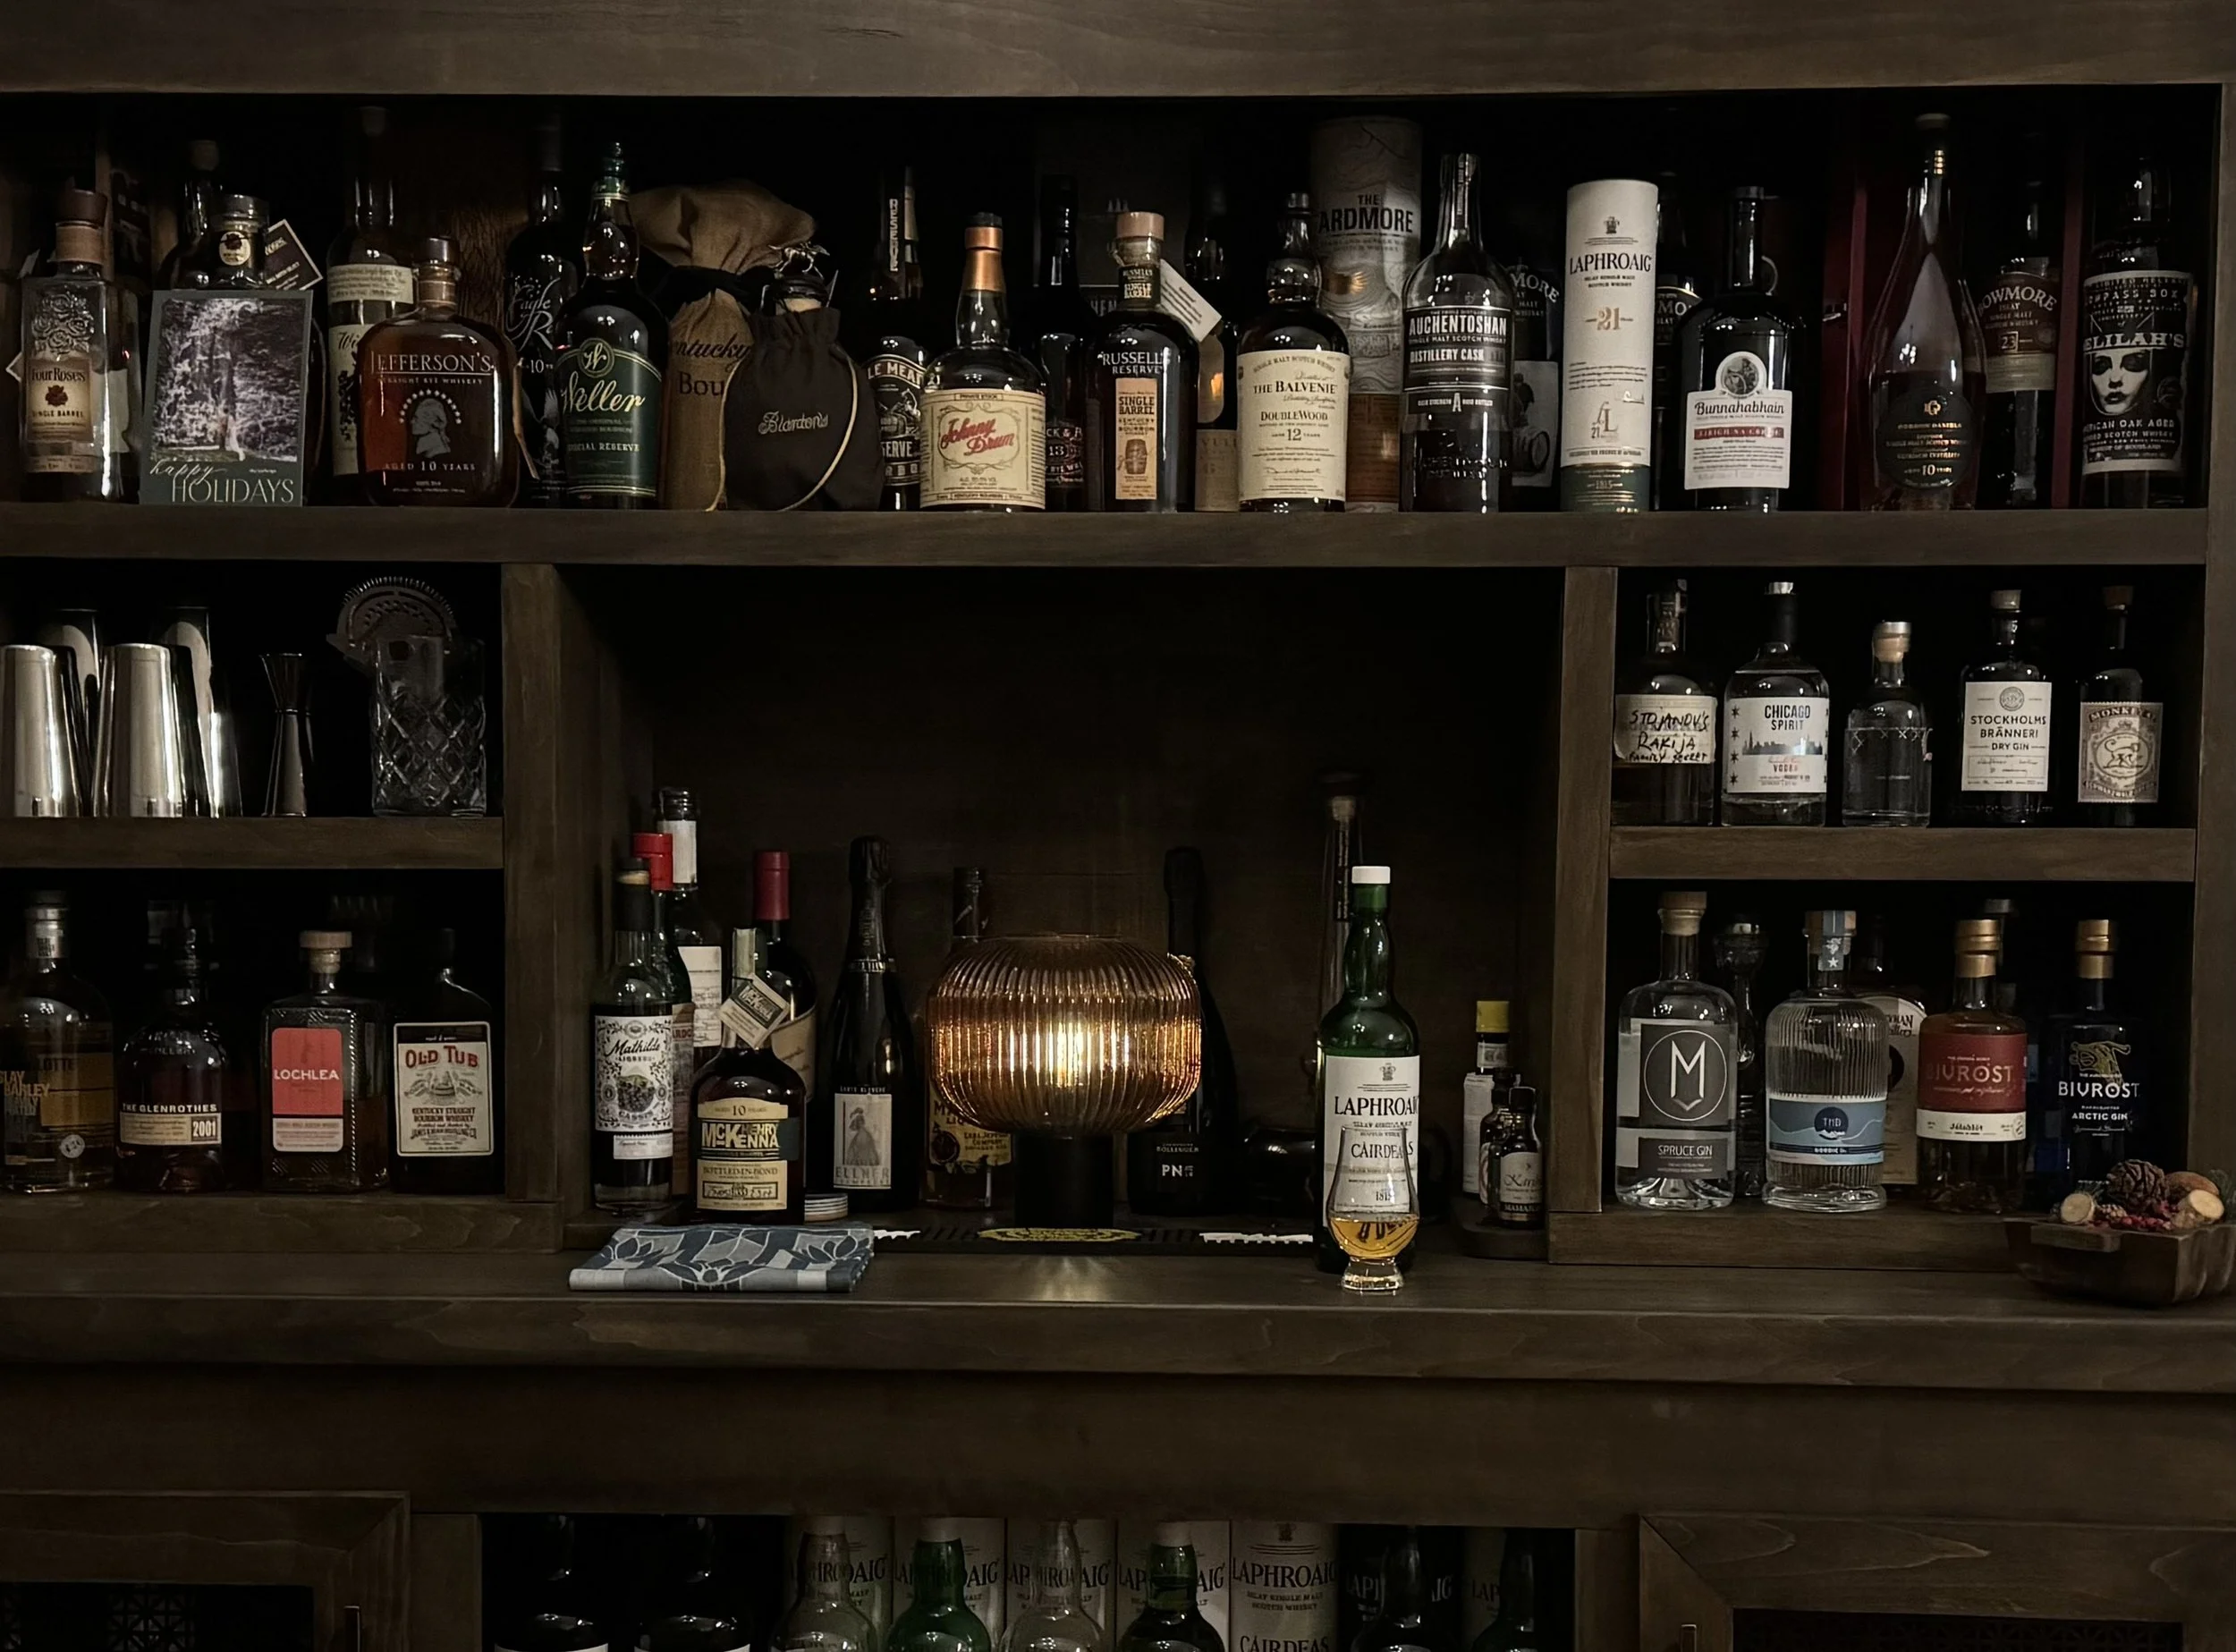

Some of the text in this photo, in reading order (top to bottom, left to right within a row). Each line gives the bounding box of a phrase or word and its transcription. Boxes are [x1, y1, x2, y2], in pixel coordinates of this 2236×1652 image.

[1359, 194, 1378, 206] THE
[1318, 207, 1413, 233] ARDMORE
[1570, 253, 1653, 275] LAPHROAIG
[1409, 314, 1508, 336] AUCHENTOSHAN
[371, 351, 492, 372] JEFFERSON'S
[1410, 348, 1485, 363] DISTILLERY CASK
[530, 360, 545, 374] 10
[1112, 365, 1163, 376] RESERVE
[54, 367, 86, 382] Roses
[560, 369, 646, 414] Weller
[1254, 380, 1338, 394] THE BALVENIE
[1118, 395, 1155, 407] SINGLE
[1694, 400, 1784, 416] Bunnahabhain
[1118, 406, 1155, 415] BARREL
[758, 411, 830, 435] Blanton's
[2119, 418, 2176, 428] OAK AGED
[941, 418, 996, 450] Johnny
[1286, 428, 1302, 442] 12
[963, 433, 1015, 457] Drum
[1049, 445, 1065, 456] 13
[420, 460, 437, 471] 10
[1921, 463, 1936, 476] 10
[171, 479, 294, 504] HOLIDAYS
[1765, 705, 1811, 719] CHICAGO
[1771, 719, 1804, 731] SPIRIT
[1970, 715, 2047, 725] STOCKHOLMS
[1991, 742, 2030, 751] DRY GIN
[605, 1037, 661, 1057] Mathilde
[405, 1045, 479, 1069] OLD TUB
[273, 1069, 340, 1080] LOCHLEA
[2058, 1080, 2140, 1098] BIVROST
[139, 1103, 218, 1113] GLENROTHES
[733, 1105, 747, 1116] 10
[2071, 1112, 2129, 1121] ARCTIC GIN
[191, 1120, 217, 1139] 2001
[1657, 1145, 1714, 1156] SPRUCE GIN
[1161, 1164, 1183, 1177] PN
